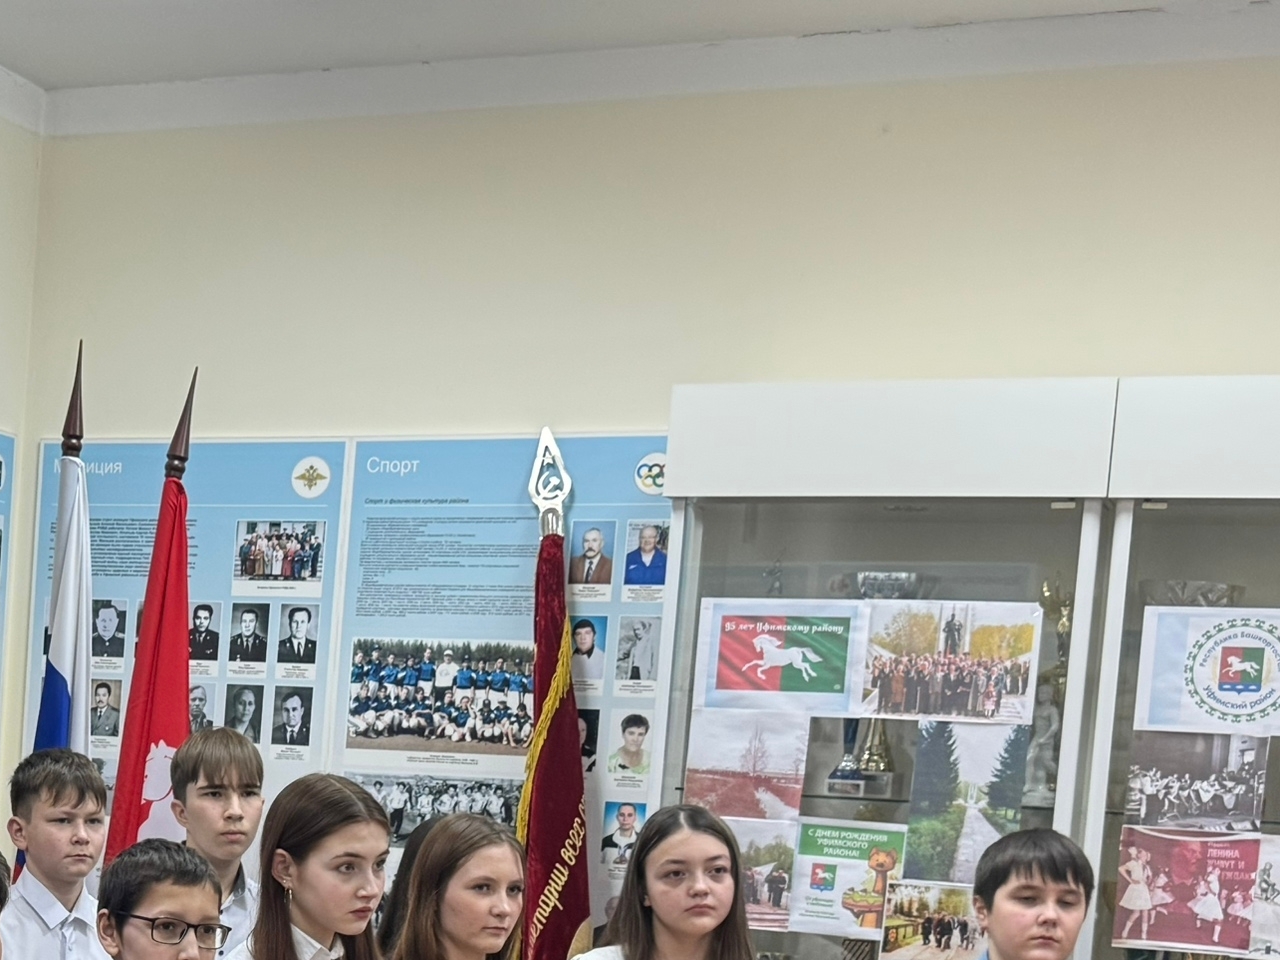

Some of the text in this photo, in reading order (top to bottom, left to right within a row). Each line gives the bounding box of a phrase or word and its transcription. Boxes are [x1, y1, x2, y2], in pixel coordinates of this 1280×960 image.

[366, 456, 420, 476] Спорт
[738, 623, 755, 631] лет
[756, 622, 810, 633] Уфимскому
[811, 623, 844, 634] району
[1199, 633, 1238, 668] Республика
[1202, 685, 1276, 709] Уфимский район
[560, 817, 585, 866] всех
[840, 832, 888, 842] РОЖДЕНИЯ
[816, 838, 868, 849] УФИМСКОГО
[823, 847, 860, 857] РАЙОНА!
[1207, 848, 1240, 859] ЛЕНИНА
